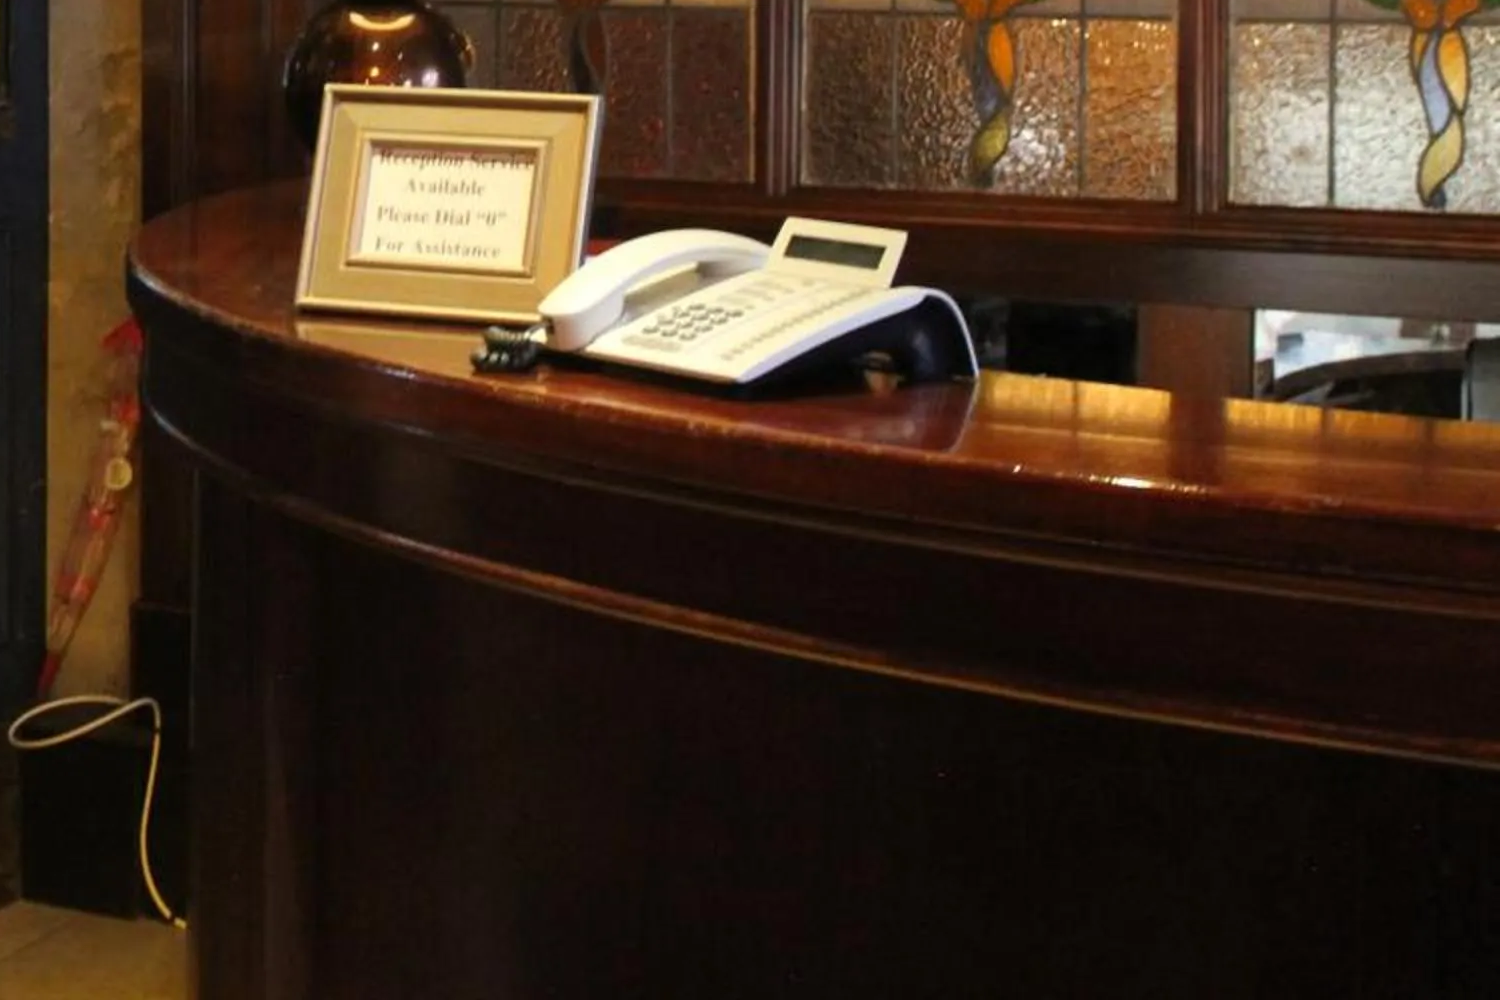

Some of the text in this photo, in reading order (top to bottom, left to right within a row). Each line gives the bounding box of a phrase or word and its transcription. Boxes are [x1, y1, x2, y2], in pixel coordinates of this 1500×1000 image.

[380, 148, 464, 170] Reception
[404, 178, 487, 197] Available
[376, 205, 429, 225] Please
[435, 208, 471, 227] Dial
[374, 235, 502, 259] For Assistance
